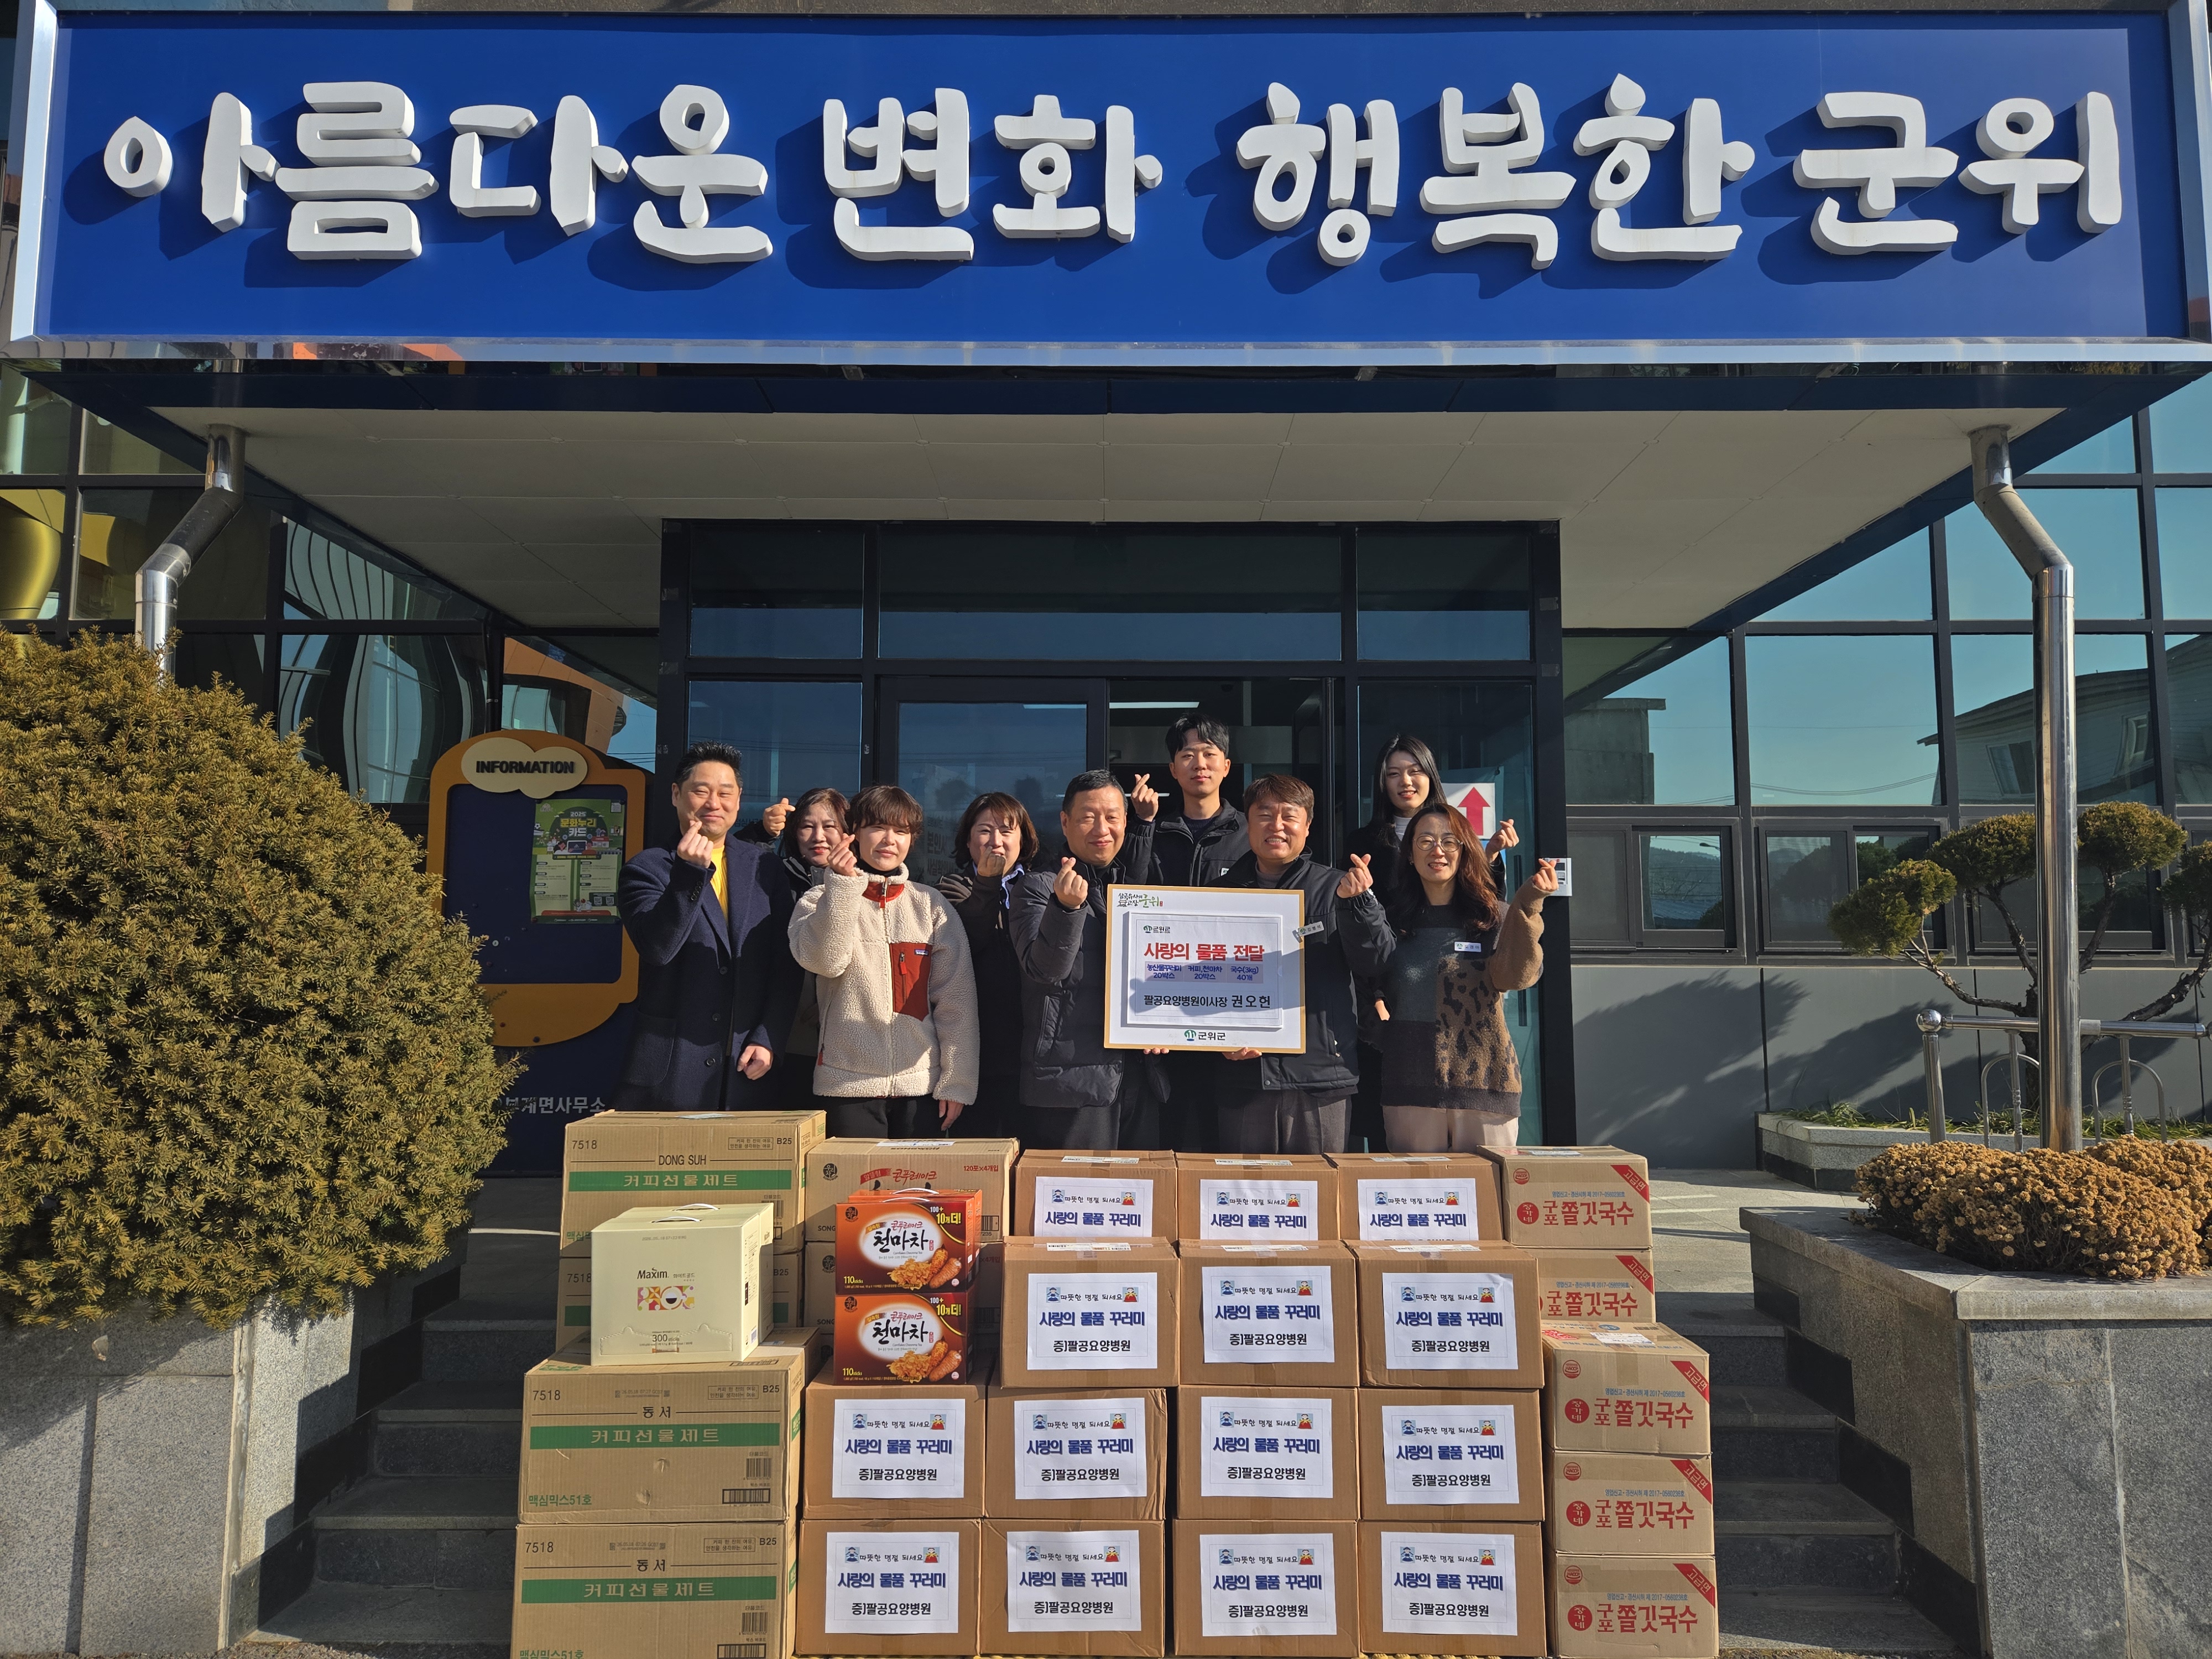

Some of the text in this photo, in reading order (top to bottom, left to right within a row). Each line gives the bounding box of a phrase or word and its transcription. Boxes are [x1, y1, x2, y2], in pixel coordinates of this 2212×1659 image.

[103, 73, 2122, 270] 아름다운 변화 행복한 군위
[476, 760, 574, 774] INFORMATION
[560, 818, 597, 828] 문화누리
[568, 827, 587, 837] 카드
[1144, 942, 1265, 962] 사랑의 물품 전달
[1144, 995, 1228, 1008] 팔공요양병원이사장
[1198, 1032, 1226, 1041] 군위군
[572, 1140, 597, 1150] 7518
[658, 1155, 707, 1165] DONG SUH
[624, 1174, 738, 1187] 커피선물세트
[892, 1168, 937, 1185] 콘푸레이크
[1623, 1169, 1646, 1192] 고급면
[1045, 1211, 1141, 1227] 사랑의 물품 꾸러미
[1543, 1200, 1634, 1226] 구포 쫄깃국수
[891, 1220, 924, 1234] 콘푸레이크
[873, 1228, 929, 1253] 천마차
[567, 1273, 591, 1283] 7518
[637, 1267, 669, 1279] Maxim
[1627, 1260, 1650, 1283] 고급면
[1060, 1293, 1082, 1302] 따뜻한
[1547, 1291, 1639, 1317] 구포 쫄깃국수
[890, 1311, 923, 1325] 콘푸레이크
[1039, 1311, 1145, 1327] 사랑의 물품 꾸러미
[1214, 1305, 1321, 1321] 사랑의 물품 꾸러미
[1395, 1311, 1504, 1327] 사랑의 물품 꾸러미
[652, 1334, 668, 1342] 300
[872, 1319, 929, 1344] 천마차
[1684, 1366, 1709, 1392] 고급면
[533, 1390, 561, 1401] 7518
[763, 1385, 780, 1393] B25
[1594, 1398, 1694, 1429] 구포 쫄깃국수
[867, 1420, 888, 1428] 따뜻한
[591, 1428, 719, 1443] 커피선물세트
[844, 1439, 952, 1455] 사랑의 물품 꾸러미
[1026, 1438, 1134, 1455] 사랑의 물품 꾸러미
[1212, 1437, 1320, 1454] 사랑의 물품 꾸러미
[1396, 1444, 1504, 1461] 사랑의 물품 꾸러미
[1683, 1464, 1709, 1491] 고급면
[528, 1494, 592, 1506] 맥심믹스51호
[1595, 1499, 1694, 1530] 구포 쫄깃국수
[525, 1542, 554, 1553] 7518
[759, 1537, 777, 1546] B25
[1415, 1554, 1437, 1563] 따뜻한
[1439, 1555, 1455, 1563] 명절
[837, 1572, 946, 1589] 사랑의 물품 꾸러미
[1394, 1572, 1504, 1592] 사랑의 물품 꾸러미
[1687, 1568, 1712, 1594] 고급면
[583, 1582, 715, 1598] 커피선물세트
[1597, 1603, 1698, 1634] 구포 쫄깃국수
